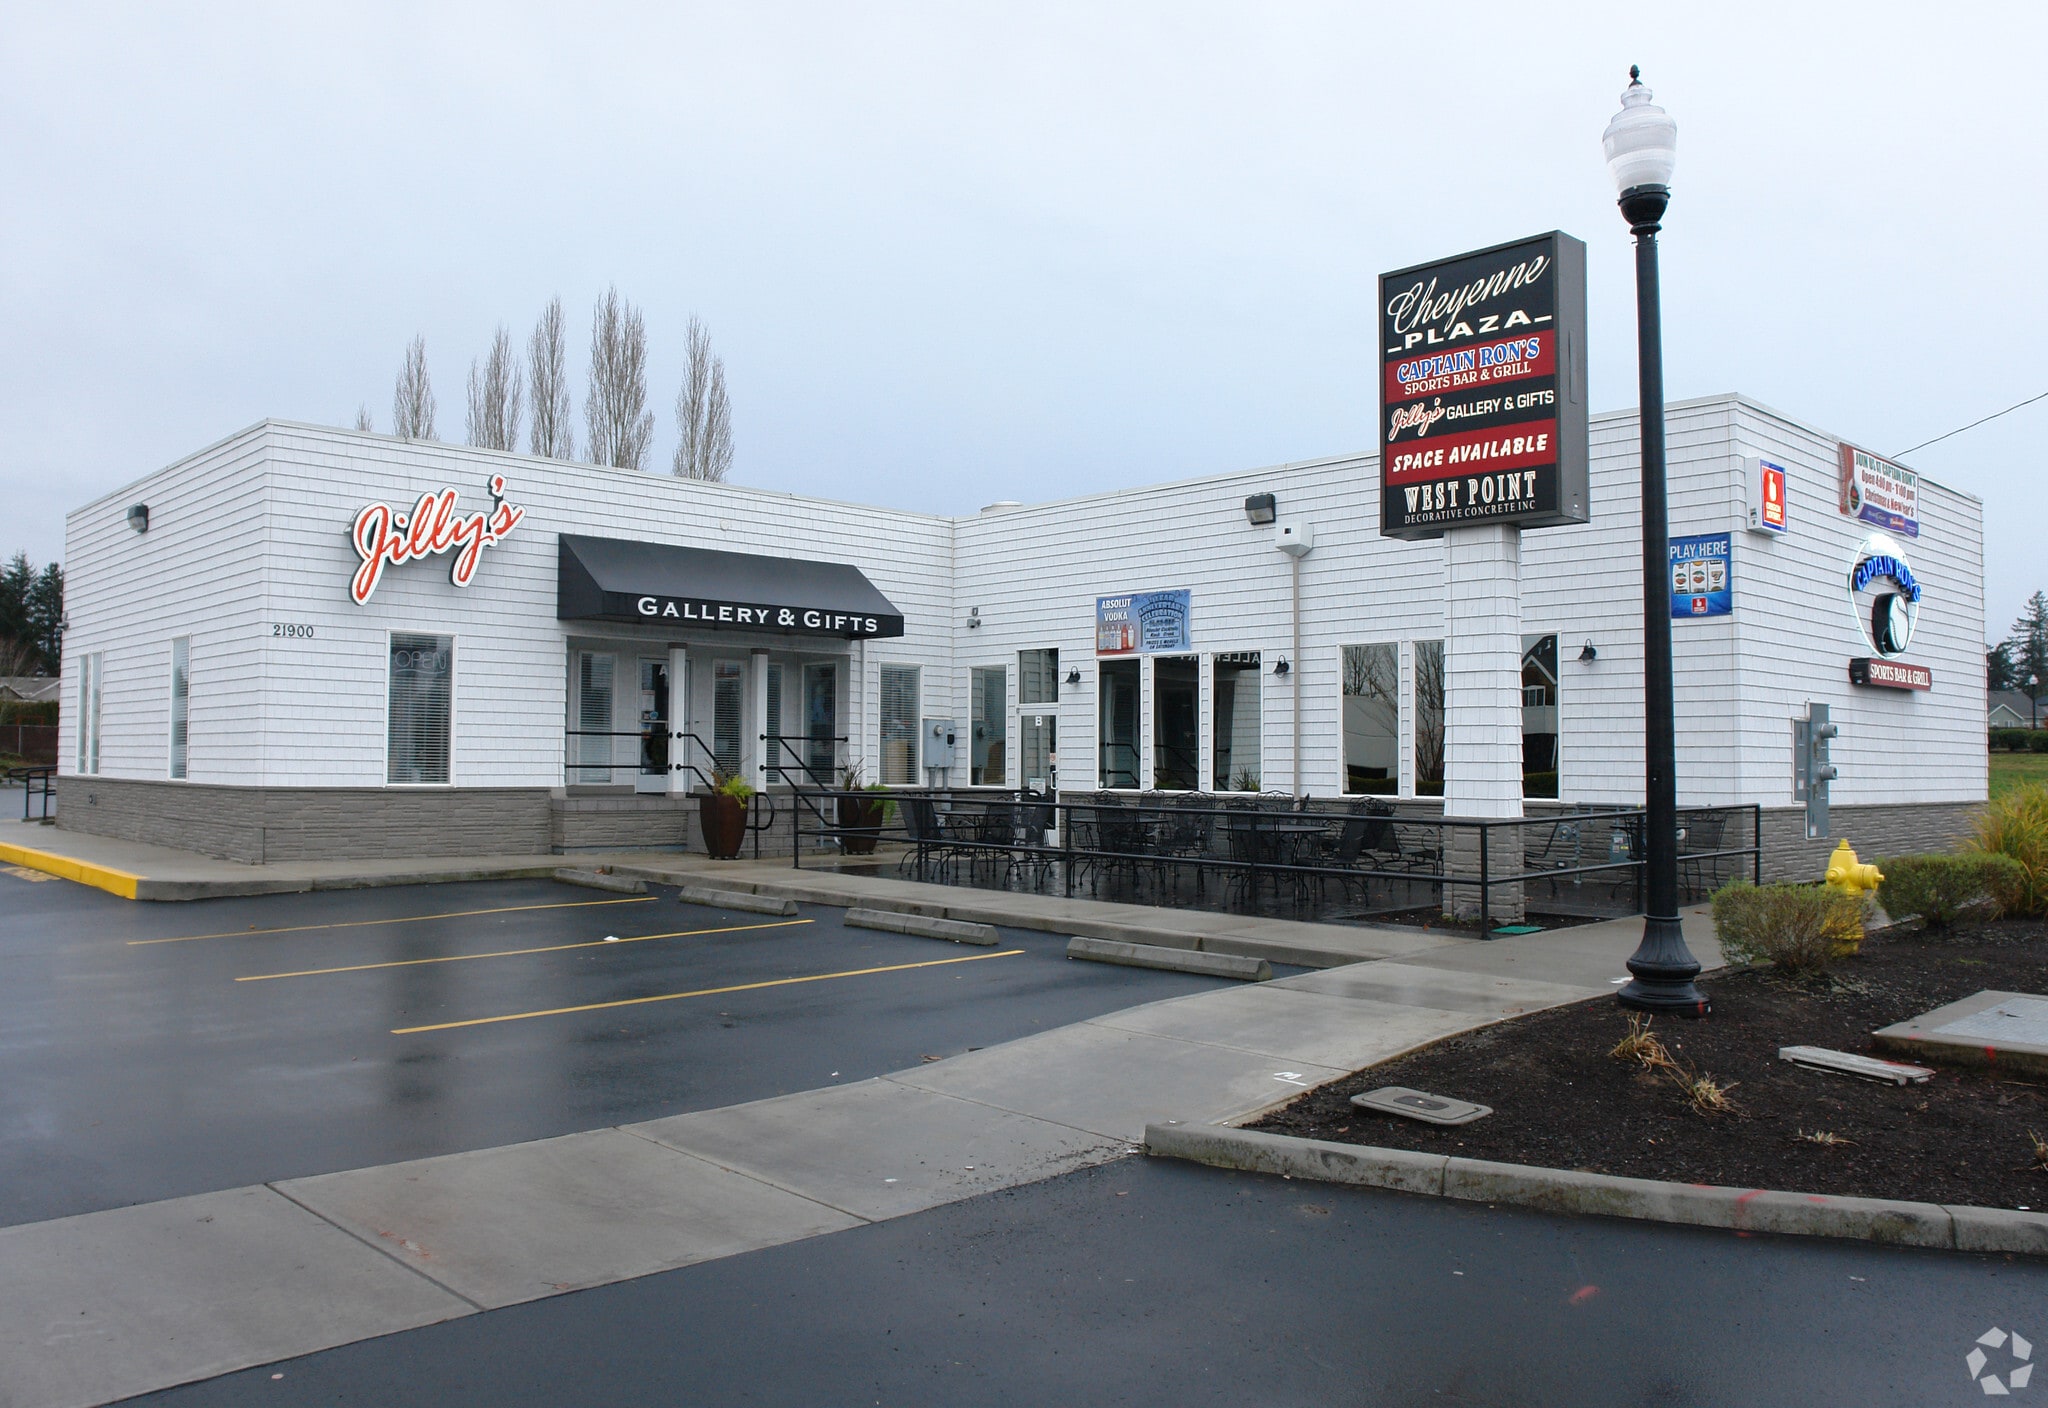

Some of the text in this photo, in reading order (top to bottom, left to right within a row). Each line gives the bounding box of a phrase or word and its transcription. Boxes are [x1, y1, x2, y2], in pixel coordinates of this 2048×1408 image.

[1387, 255, 1550, 334] Cheyenne
[1397, 337, 1540, 383] CAPTAIN RON'S
[1405, 362, 1531, 395] SPORTS BAR & GRILL
[1389, 390, 1554, 442] Jilly's GALLERY & GIFTS
[1393, 434, 1548, 472] SPACE AVAILABLE
[1404, 471, 1536, 513] WEST POINT
[1404, 500, 1536, 524] DECORATIVE CONCRETE INC
[353, 474, 526, 604] Jilly's
[1670, 540, 1728, 559] PLAY HERE
[1856, 556, 1893, 591] CAPTAIN
[1101, 598, 1131, 609] ABSOLUT
[777, 608, 795, 626] &
[1104, 611, 1128, 621] VODKA
[273, 624, 314, 638] 21900
[395, 650, 447, 669] OPEN
[1870, 663, 1930, 686] SPORTS BAR & GRILL
[1035, 716, 1042, 726] B
